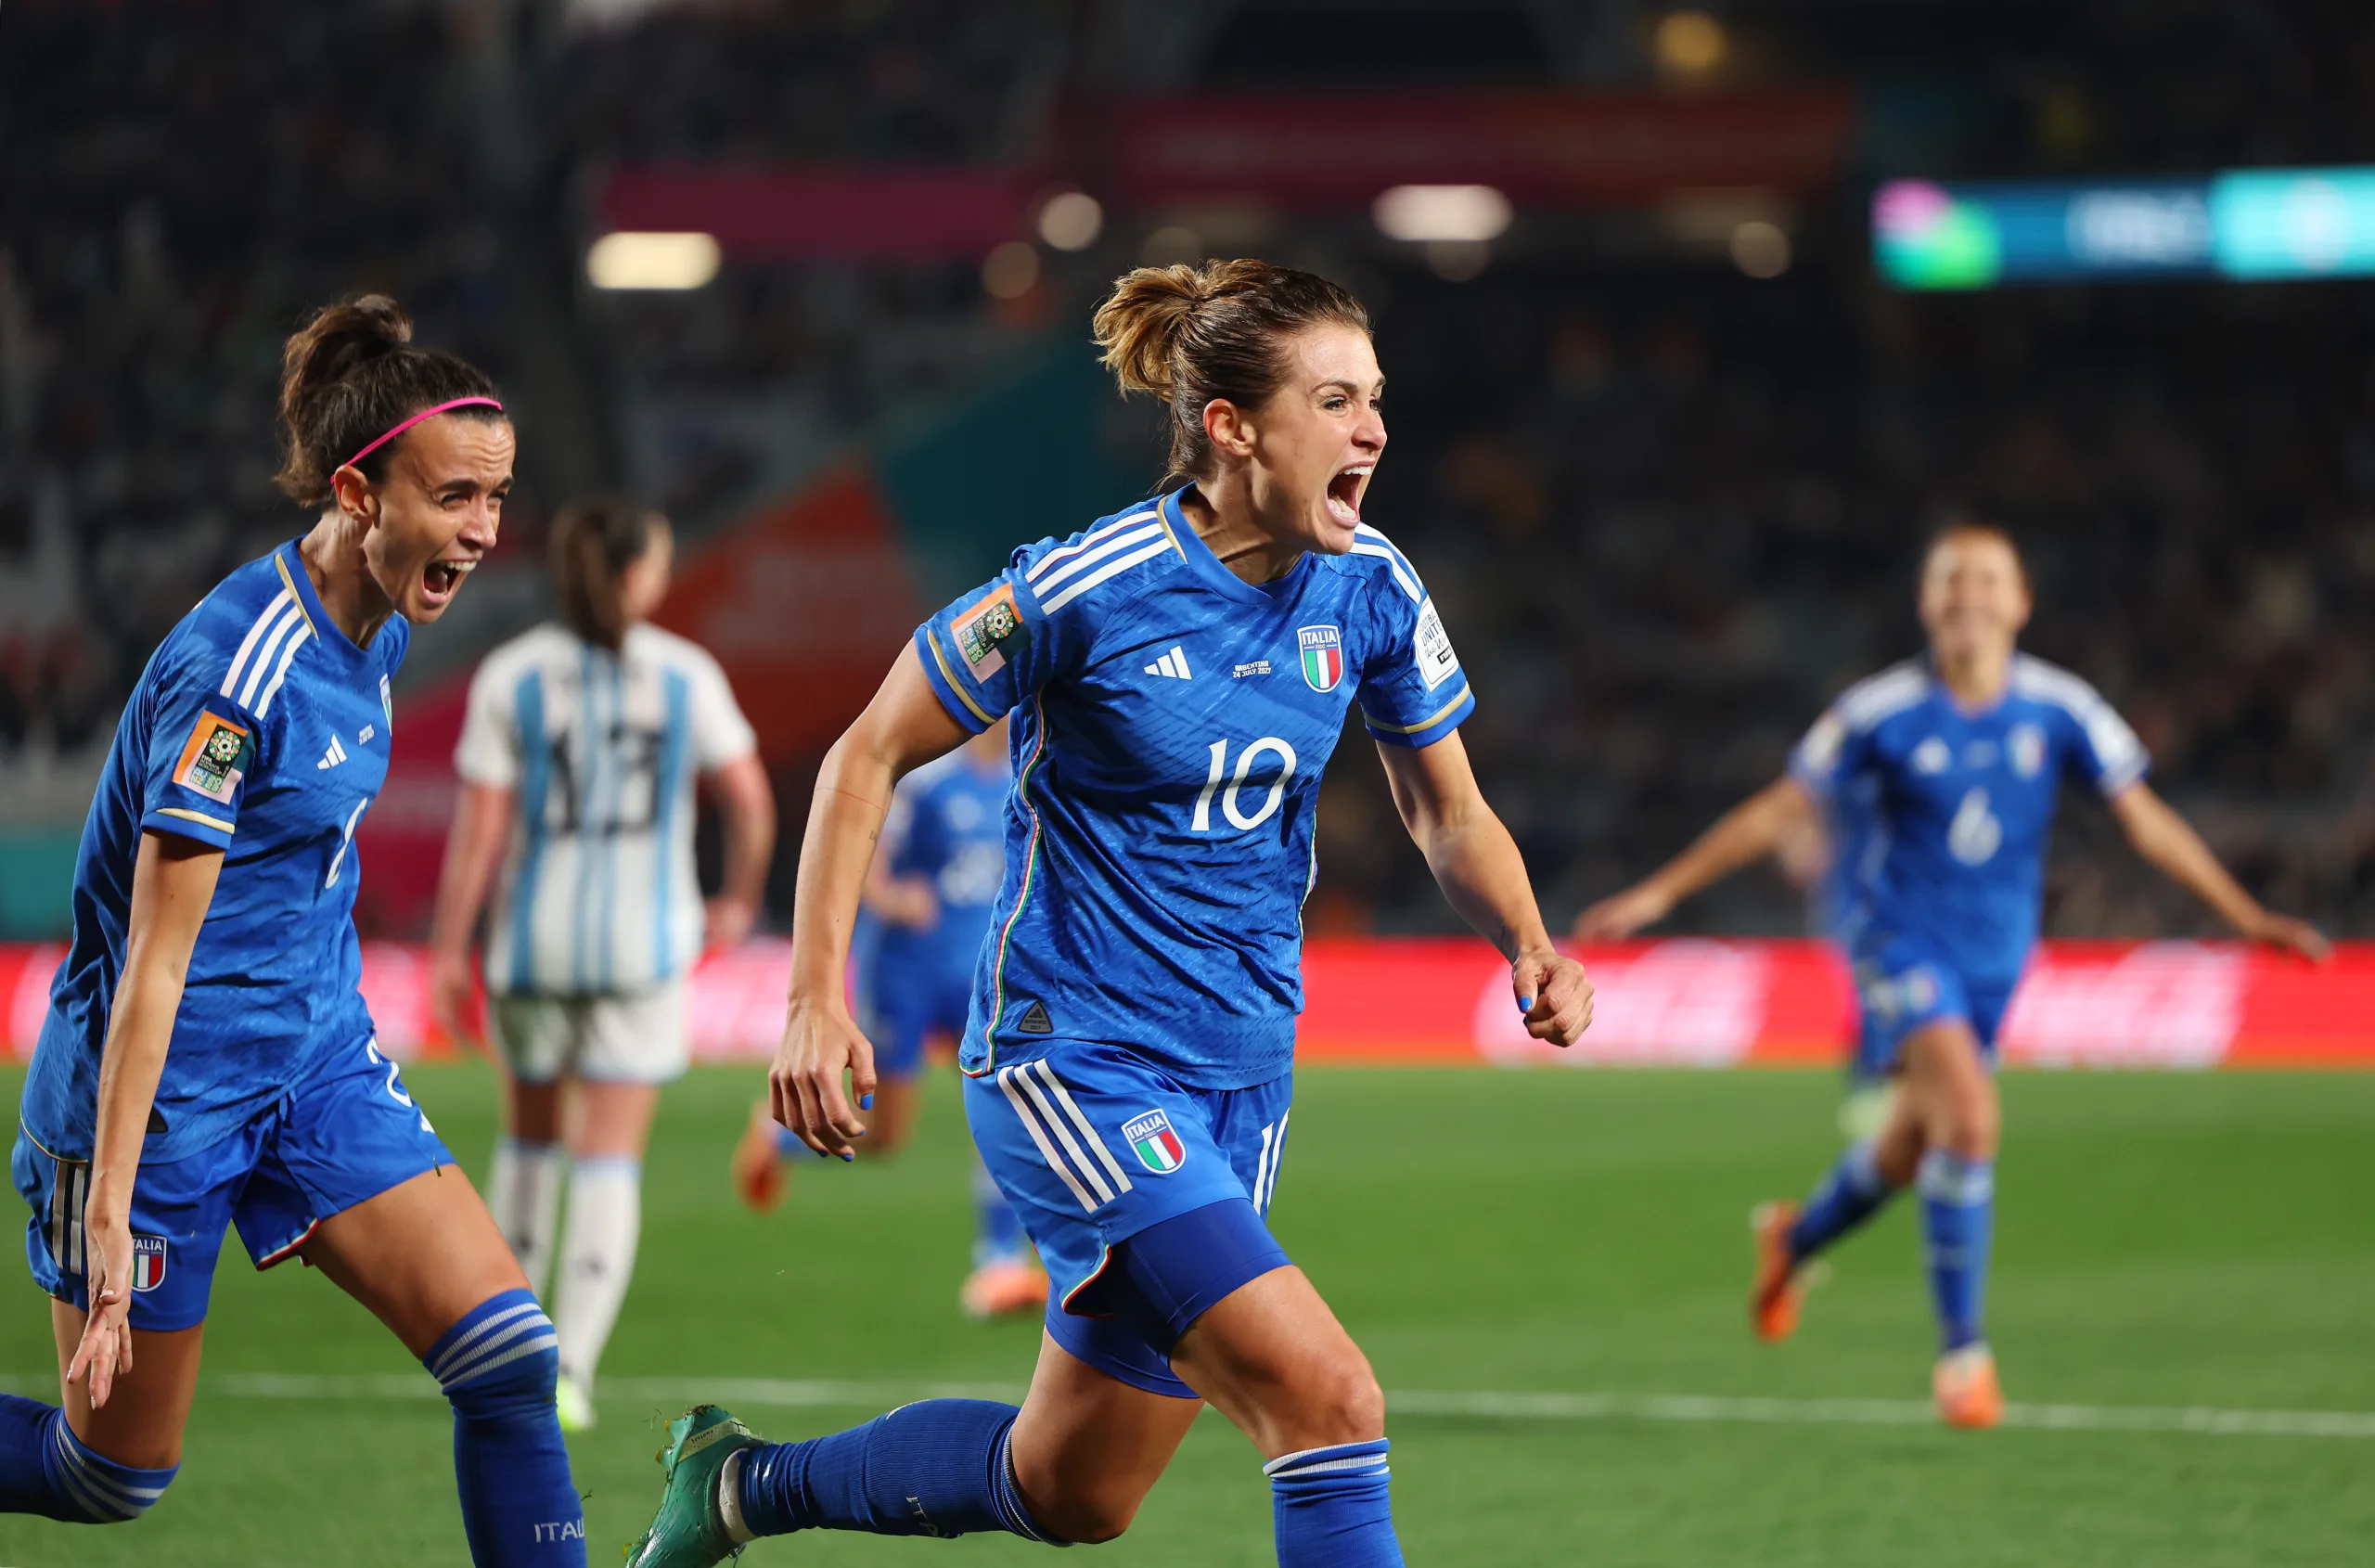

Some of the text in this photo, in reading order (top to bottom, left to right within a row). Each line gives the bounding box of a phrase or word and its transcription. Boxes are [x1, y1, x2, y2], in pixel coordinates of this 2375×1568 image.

[1419, 611, 1438, 635] FOOTBA
[1421, 618, 1444, 647] UNITE
[1302, 630, 1337, 646] ITALIA
[1235, 660, 1269, 671] ARGENTINA
[1241, 668, 1256, 677] JULY
[1191, 737, 1297, 830] 10
[1946, 785, 2003, 867] 6
[1126, 1114, 1165, 1139] ITALIA
